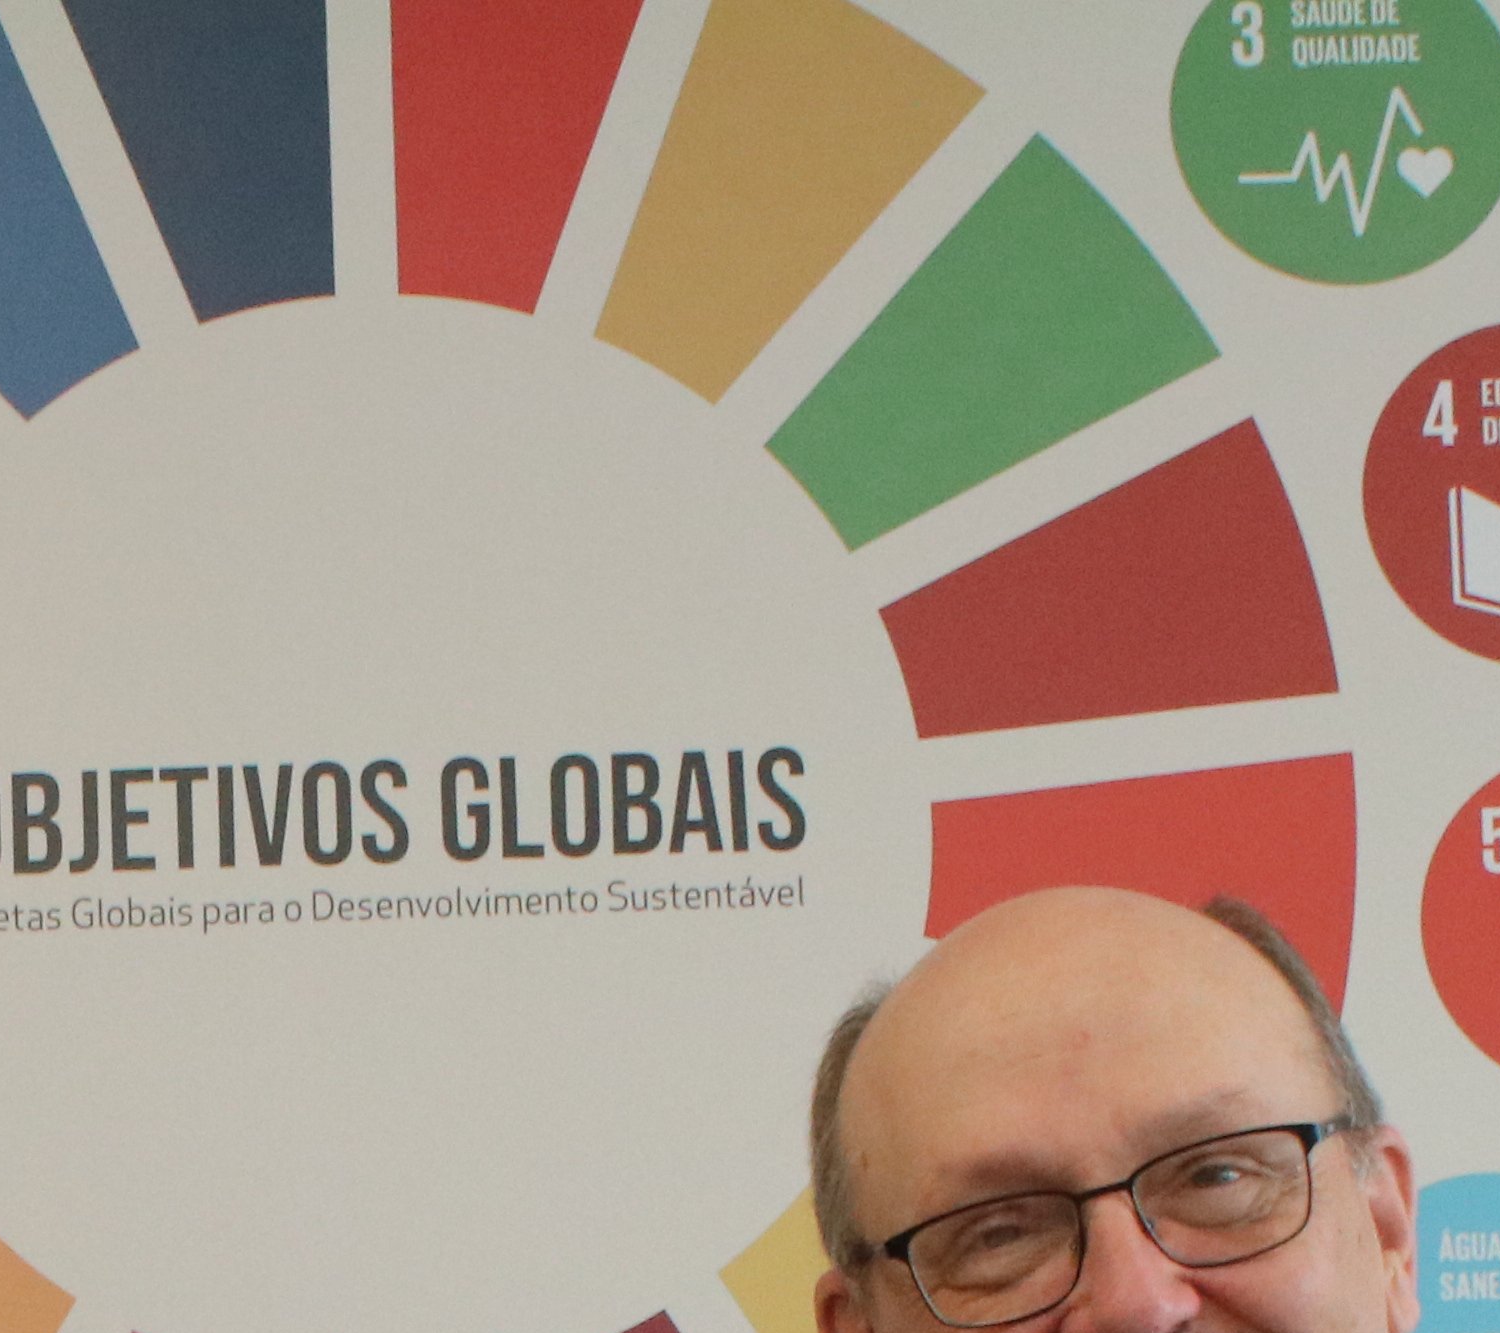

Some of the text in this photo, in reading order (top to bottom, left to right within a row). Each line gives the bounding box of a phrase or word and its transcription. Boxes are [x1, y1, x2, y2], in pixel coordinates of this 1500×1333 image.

[1231, 1, 1265, 68] 3
[1370, 0, 1400, 26] DE
[1292, 33, 1422, 68] QUALIDADE
[1422, 378, 1458, 447] 4
[440, 745, 807, 863] GLOBAIS
[70, 896, 193, 930] Globais
[202, 900, 275, 935] para
[284, 904, 302, 923] o
[311, 885, 599, 922] Desenvolvimento
[606, 874, 807, 914] Sustentável
